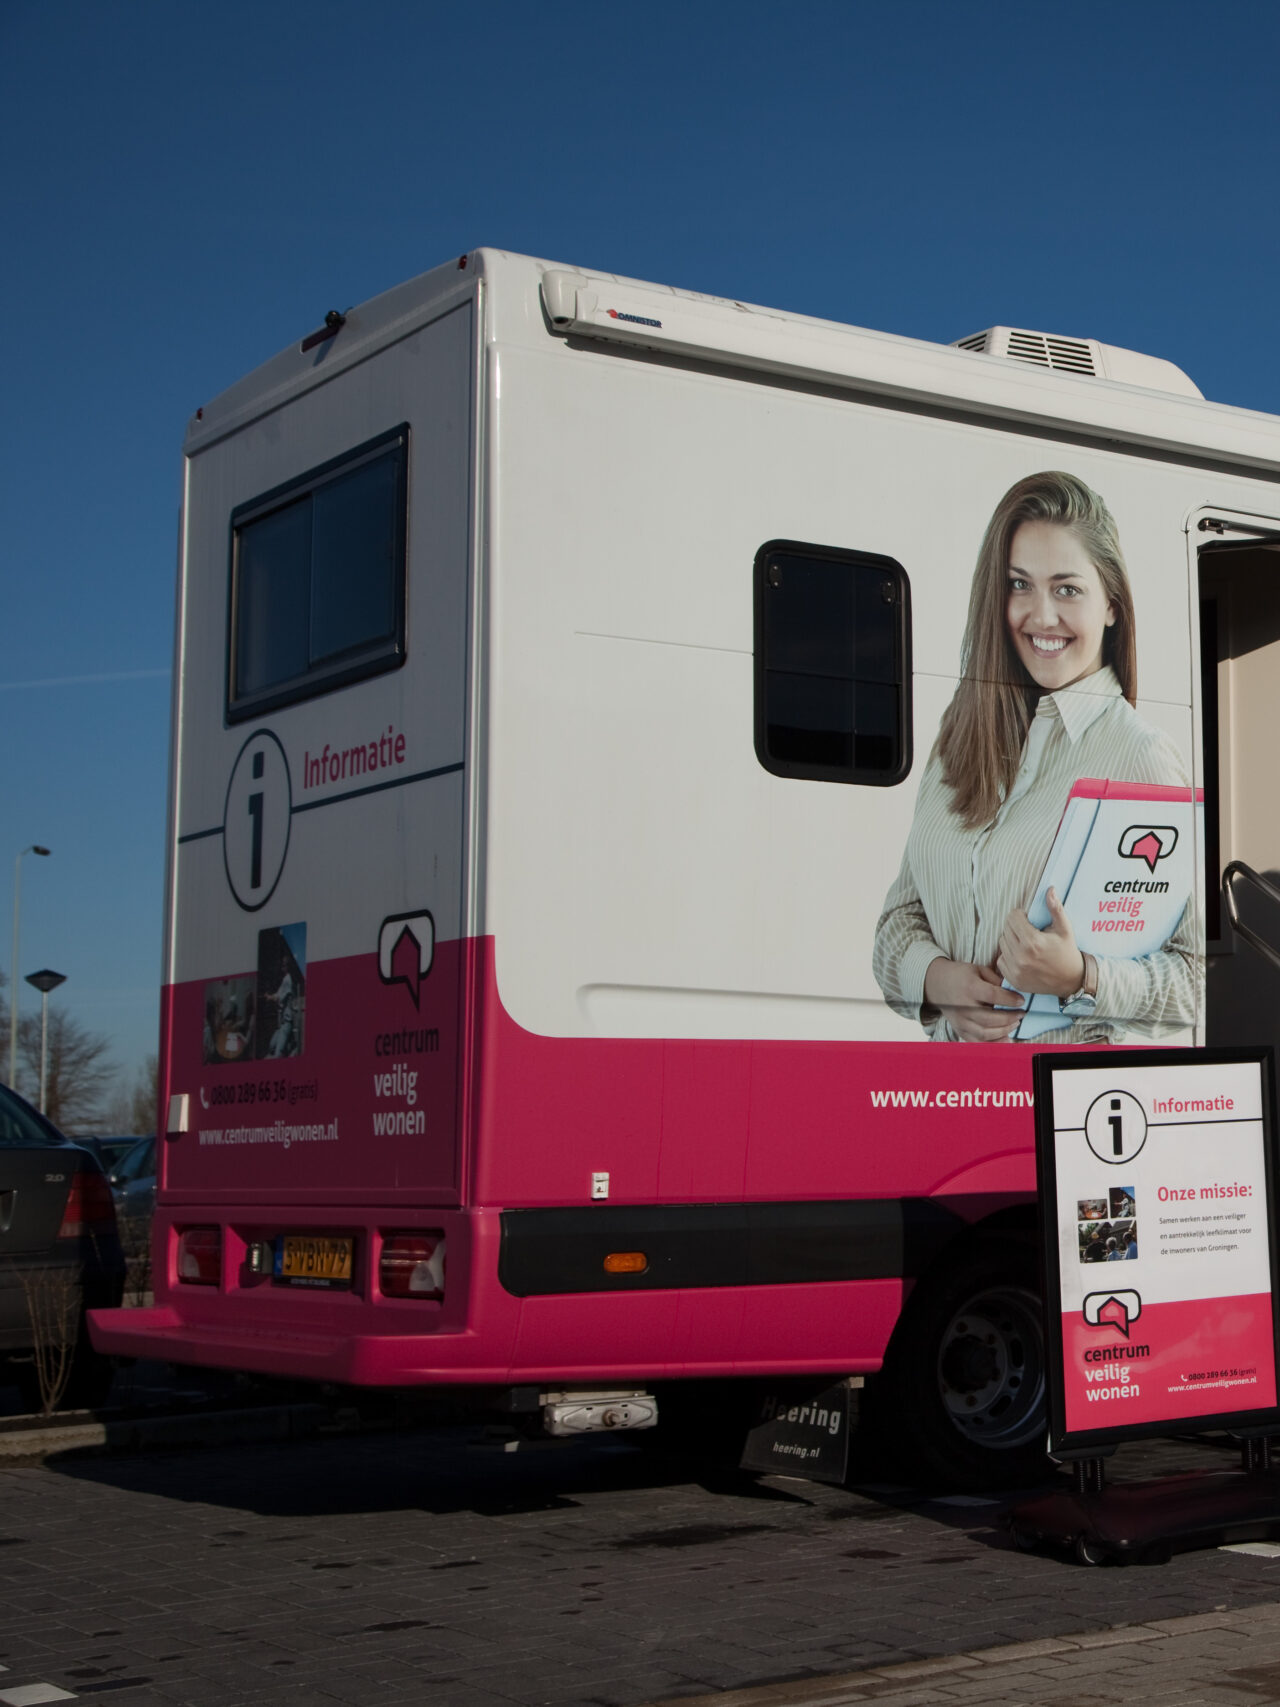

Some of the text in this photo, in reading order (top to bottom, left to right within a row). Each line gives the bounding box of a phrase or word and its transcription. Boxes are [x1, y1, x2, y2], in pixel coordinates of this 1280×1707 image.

[617, 312, 663, 329] OMNISTOR
[303, 725, 406, 789] Informatie
[1104, 879, 1169, 893] centrum
[1098, 897, 1143, 917] veilig
[1091, 919, 1145, 932] wonen
[374, 1026, 440, 1057] centrum
[211, 1085, 235, 1105] 0800
[238, 1082, 256, 1104] 289
[258, 1080, 271, 1102] 66
[273, 1079, 286, 1102] 36
[374, 1063, 418, 1105] veilig
[1153, 1095, 1234, 1113] Informatie
[373, 1109, 425, 1136] wonen
[199, 1117, 339, 1149] www.centrumveiligwonen.nl
[1157, 1182, 1253, 1202] Onze missie:
[1159, 1217, 1178, 1225] Samen
[1180, 1215, 1200, 1223] werken
[1225, 1212, 1246, 1221] veiliger
[1168, 1230, 1205, 1239] aantrekkelijk
[1206, 1228, 1238, 1237] leefklimaat
[1160, 1247, 1168, 1255] de
[1170, 1246, 1196, 1254] inwoners
[1208, 1244, 1239, 1252] Groningen.
[1084, 1344, 1150, 1362] centrum
[1084, 1363, 1131, 1384] veilig
[1188, 1372, 1206, 1381] 0800
[1207, 1371, 1219, 1379] 289
[1220, 1369, 1229, 1377] 66
[1229, 1368, 1238, 1377] 36
[1086, 1383, 1140, 1402] wonen
[1167, 1376, 1257, 1392] www.centrumveiligwonen.nl
[773, 1442, 820, 1459] heering.nl
